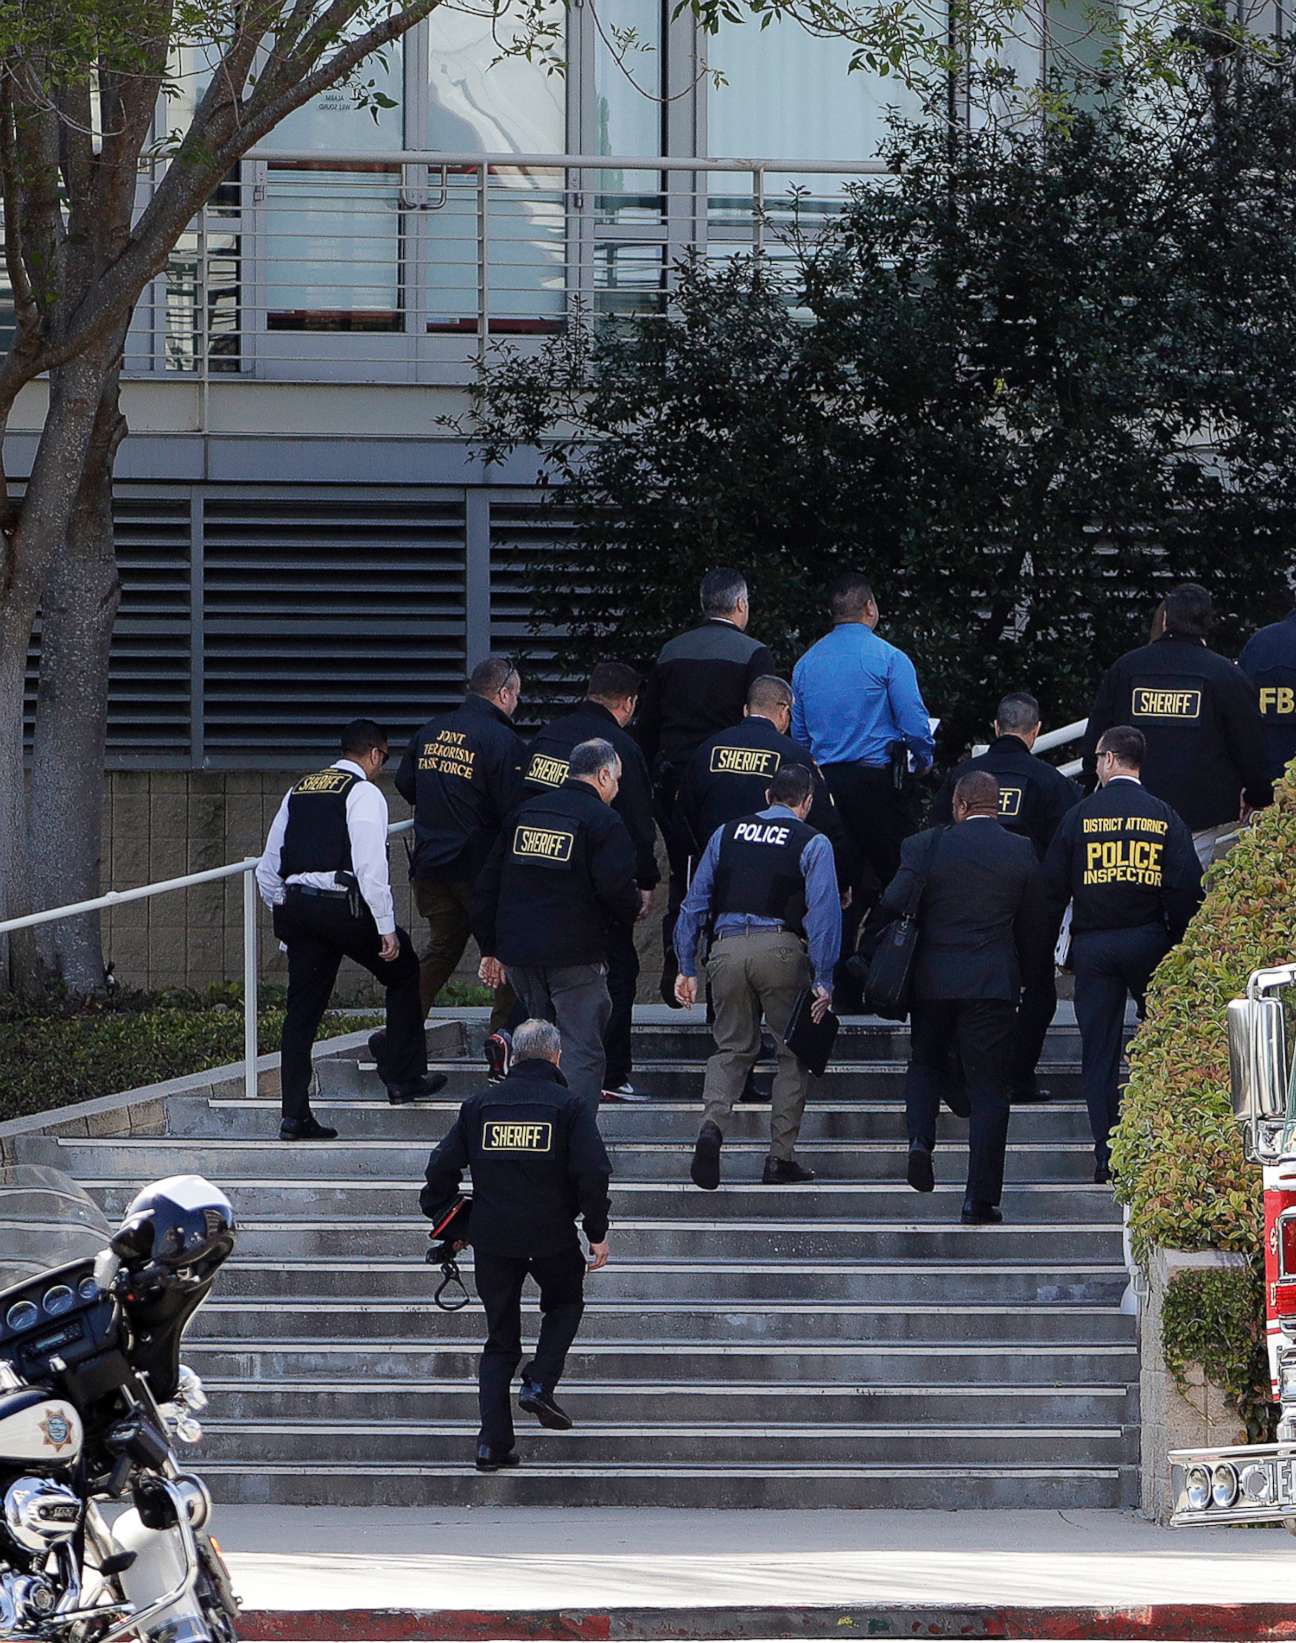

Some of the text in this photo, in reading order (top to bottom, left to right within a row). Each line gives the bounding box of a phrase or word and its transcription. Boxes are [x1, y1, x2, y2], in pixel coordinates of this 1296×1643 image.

[1140, 692, 1192, 714] SHERIFF
[436, 730, 466, 745] JOINT
[424, 743, 475, 764] TERRORISM
[718, 749, 771, 772] SHERIFF
[418, 757, 474, 780] TASK FORCE
[298, 774, 345, 791] SHERIFF
[733, 823, 790, 846] POLICE
[1083, 817, 1123, 833] DISTRICT
[521, 831, 565, 856] SHERIFF
[1087, 840, 1164, 871] POLICE
[1083, 866, 1163, 887] INSPECTOR
[491, 1125, 543, 1148] SHERIFF
